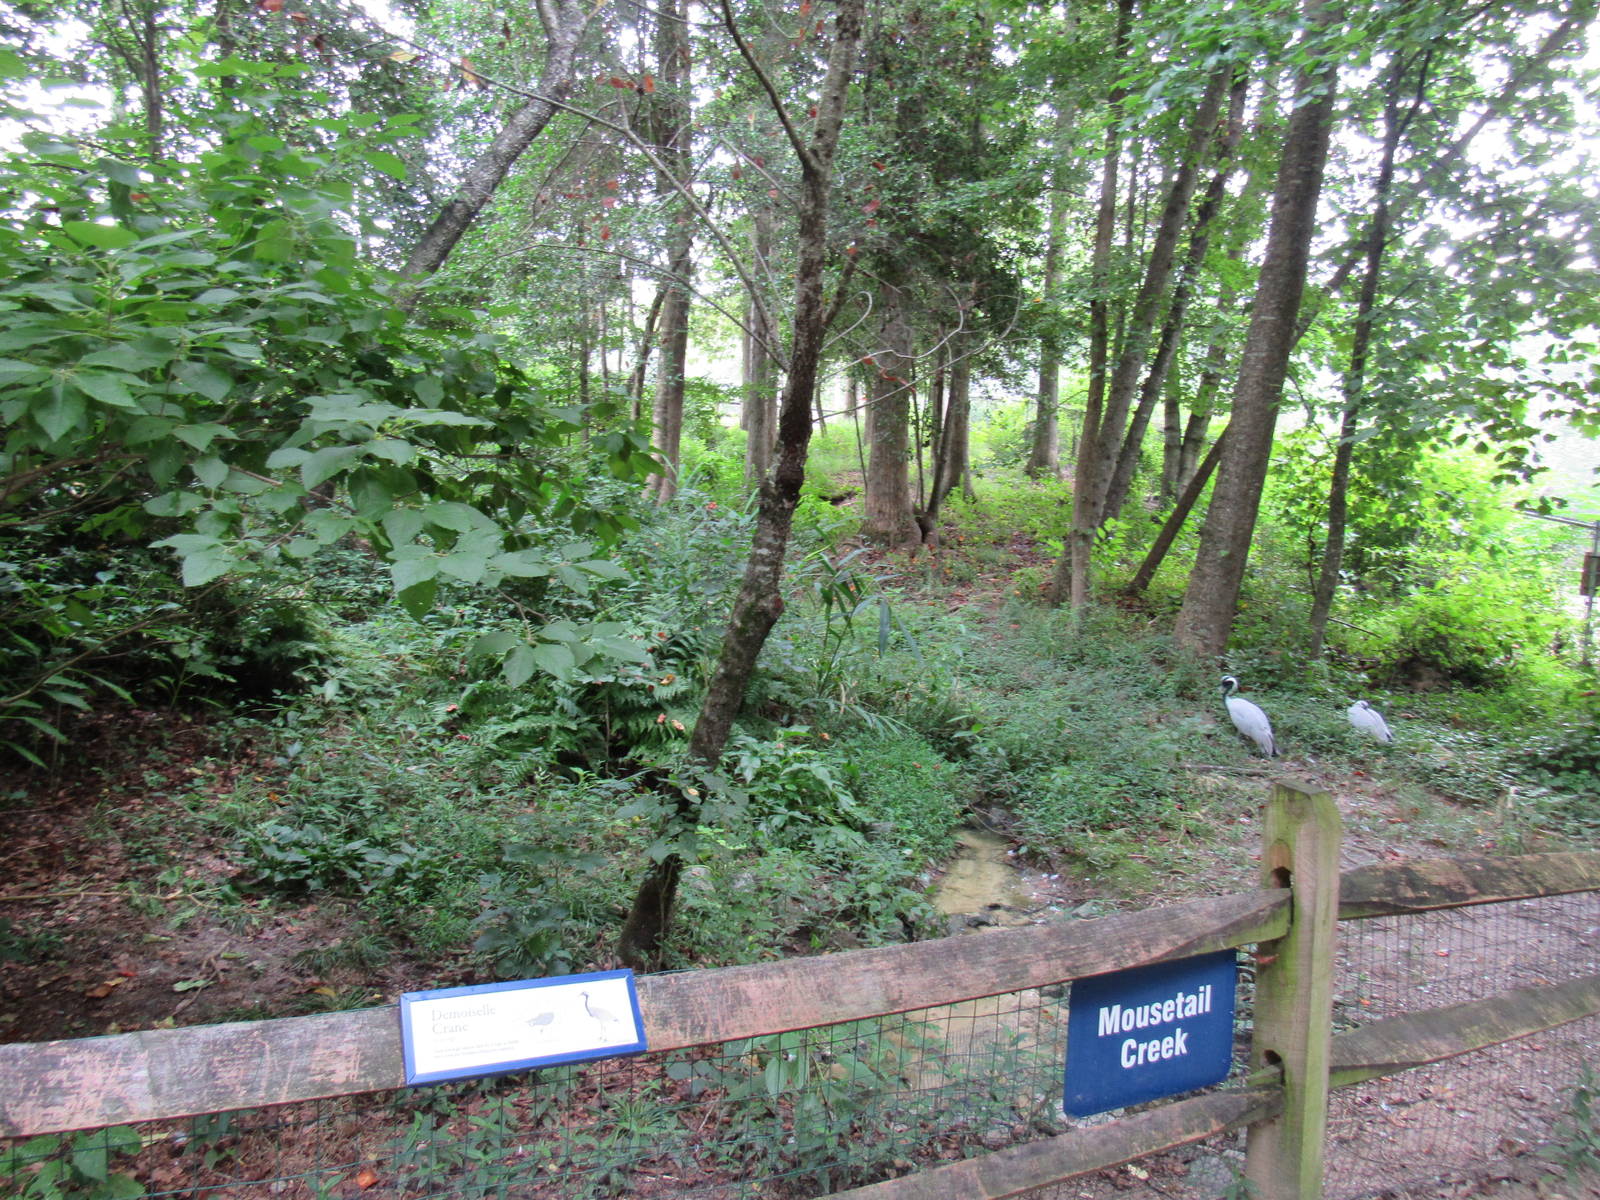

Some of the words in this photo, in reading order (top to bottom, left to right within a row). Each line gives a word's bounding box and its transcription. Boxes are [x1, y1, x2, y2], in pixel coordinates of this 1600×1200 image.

[431, 1004, 496, 1022] Demoiselle
[1098, 985, 1211, 1036] Mousetail
[432, 1023, 469, 1035] Crane
[1121, 1028, 1188, 1069] Creek
